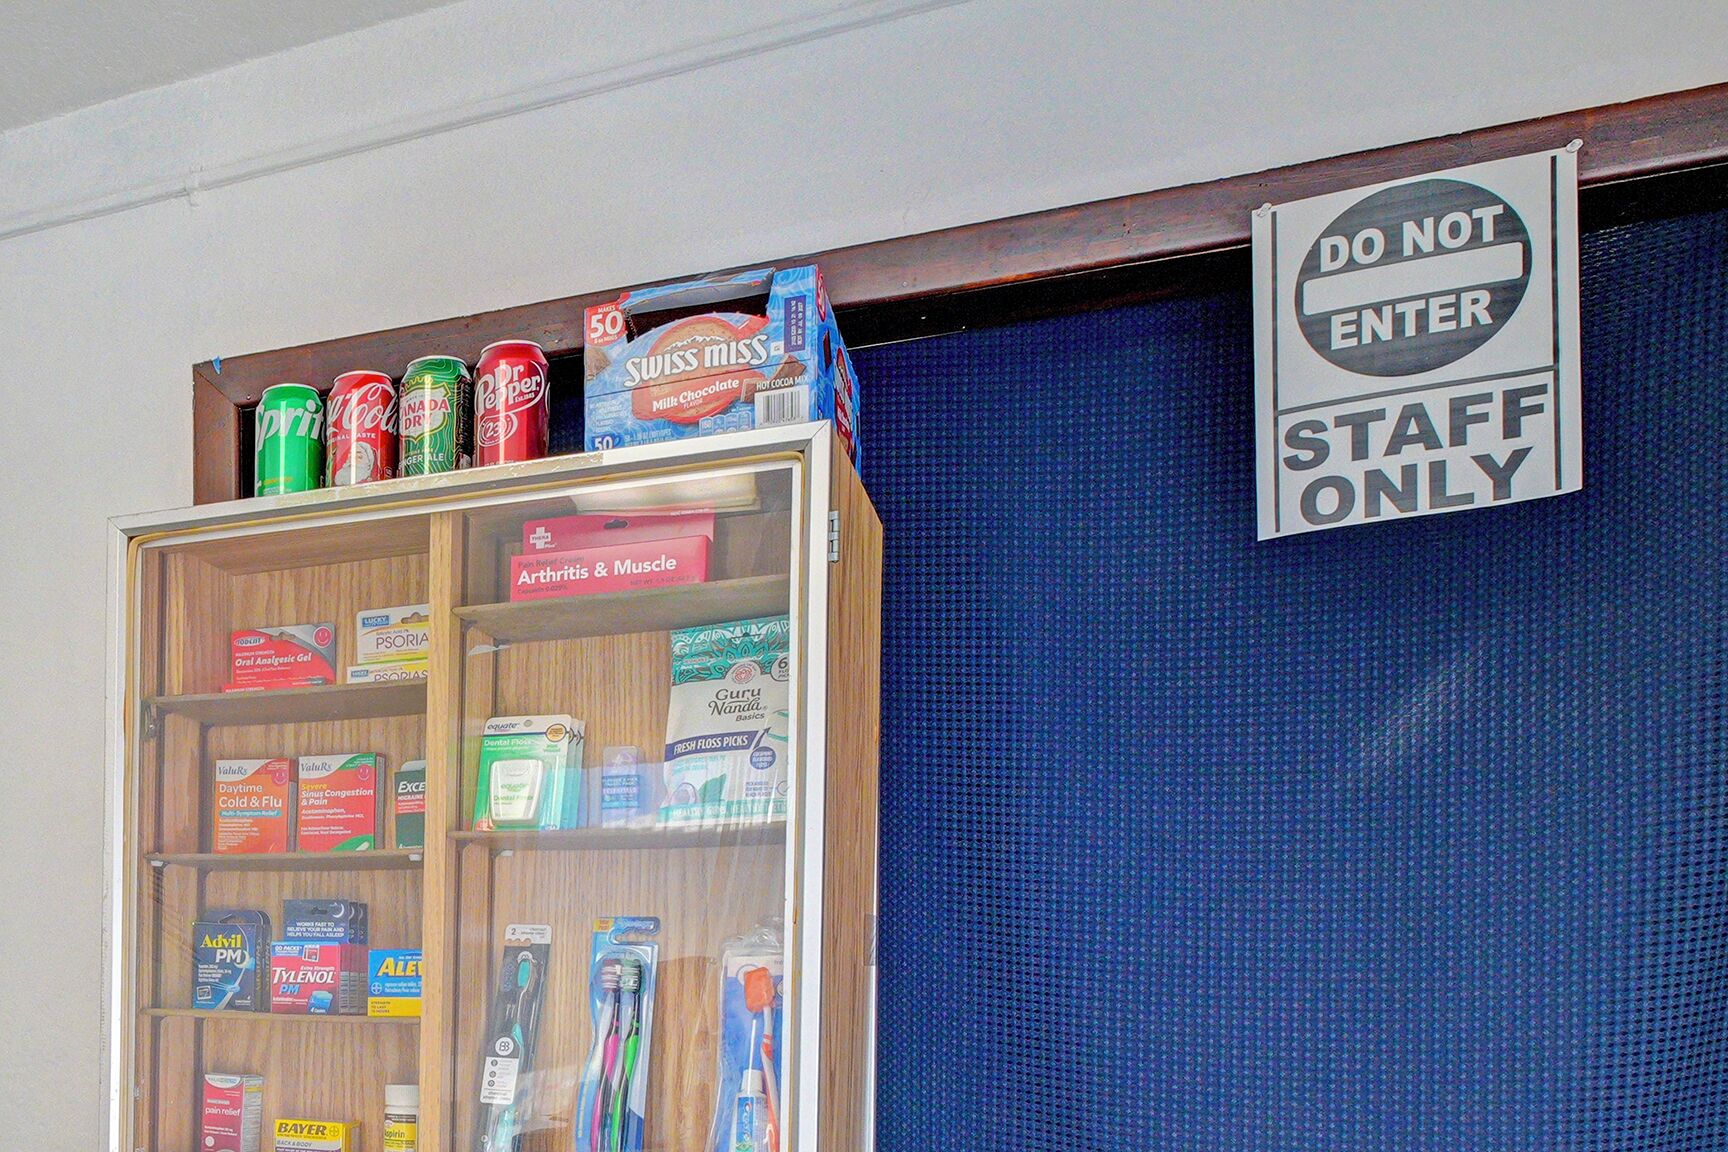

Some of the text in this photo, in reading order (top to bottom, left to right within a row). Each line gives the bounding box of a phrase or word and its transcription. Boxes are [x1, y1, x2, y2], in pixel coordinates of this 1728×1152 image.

[1319, 203, 1505, 274] DO NOT
[589, 310, 624, 339] 50
[1330, 288, 1494, 351] ENTER
[494, 364, 525, 390] Dr
[756, 380, 770, 391] HOT
[772, 377, 793, 389] COCOA
[475, 374, 541, 416] Pepper
[652, 377, 740, 412] Milk Chocolate
[485, 421, 503, 438] 23
[1282, 383, 1549, 472] STAFF
[1299, 445, 1534, 526] ONLY
[517, 554, 677, 585] Arthritis & Muscle
[376, 633, 429, 650] PSORIA
[235, 652, 312, 667] Oral Analgesic Gel
[715, 687, 761, 701] Guru
[708, 697, 762, 716] Nanda
[735, 712, 765, 722] Basics
[487, 722, 517, 731] equate
[673, 735, 749, 755] FRESH FLOSS PICKS
[219, 782, 263, 795] Daytime
[301, 787, 374, 799] Sinus Congestion
[219, 795, 282, 808] Cold & Flu
[301, 798, 328, 806] & Pain
[200, 933, 242, 948] Advil
[215, 948, 242, 963] PM
[271, 967, 335, 984] TYLENOL
[279, 983, 300, 995] PM
[205, 1106, 241, 1117] pain relief
[277, 1122, 327, 1136] BAYER
